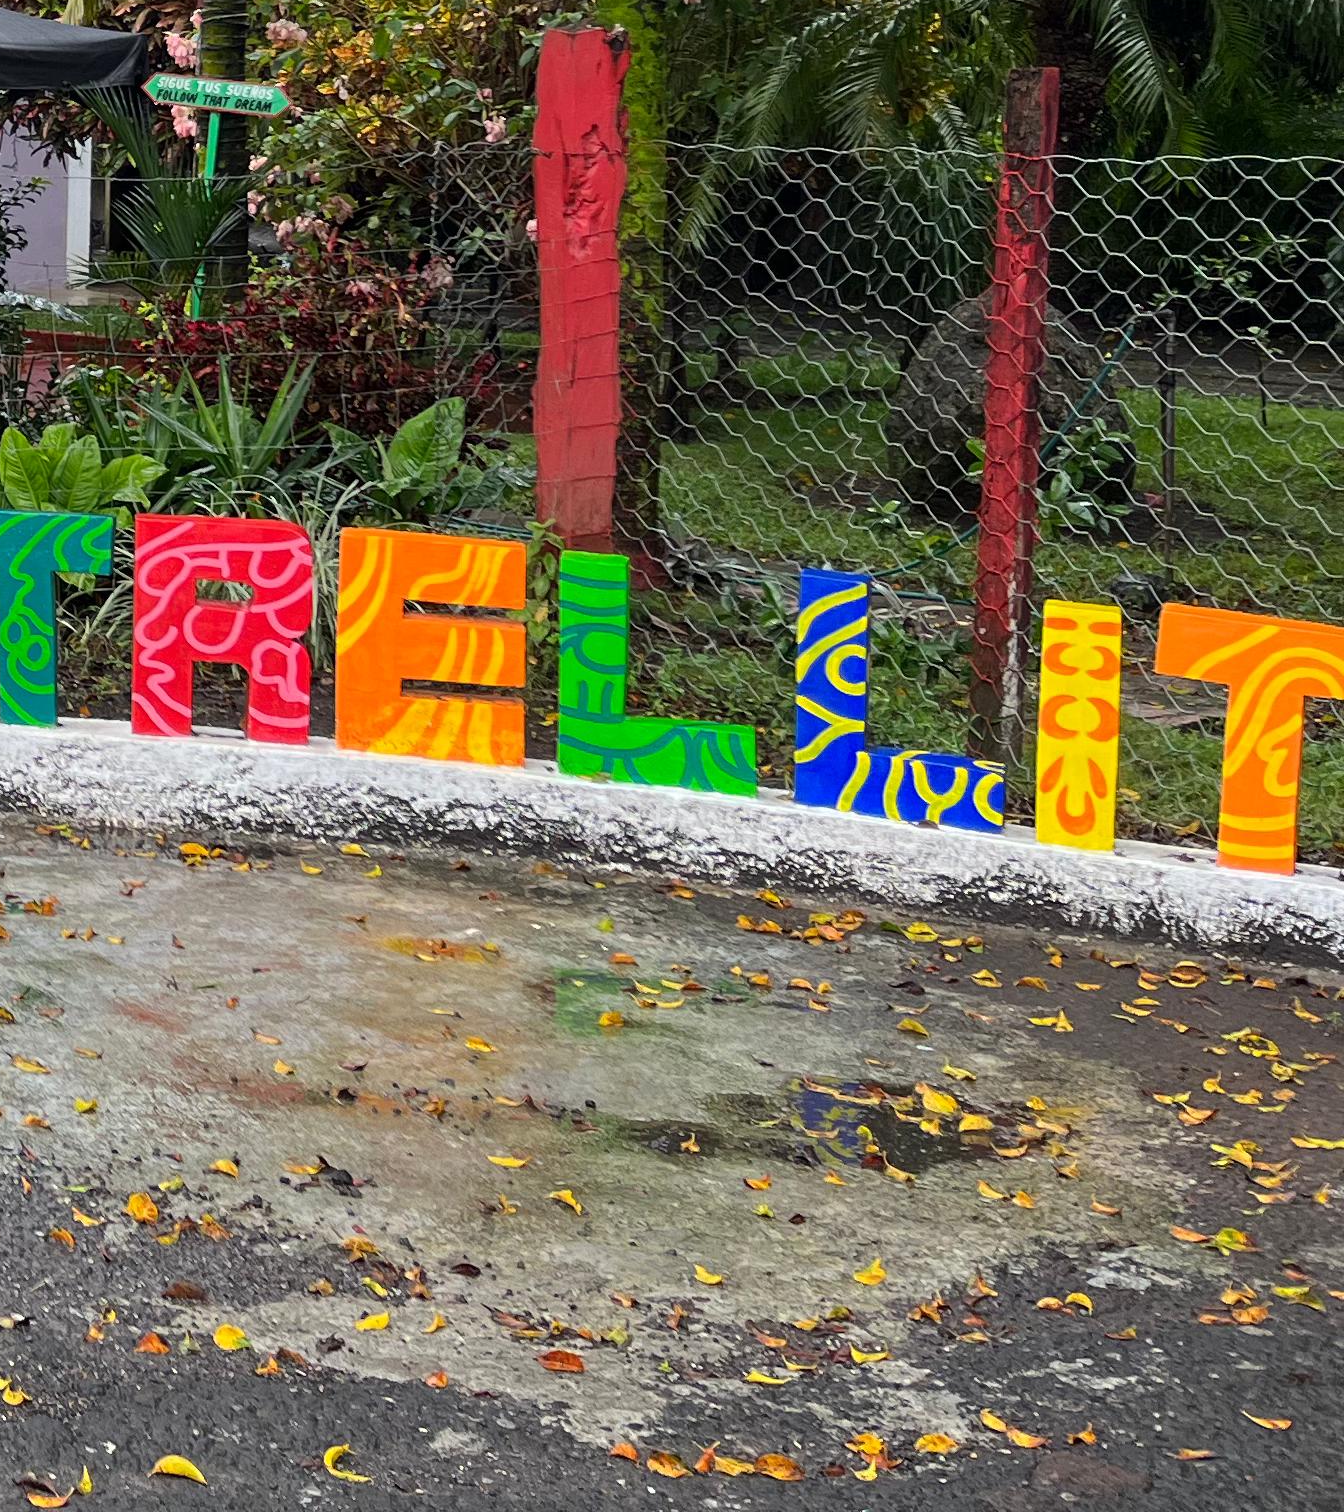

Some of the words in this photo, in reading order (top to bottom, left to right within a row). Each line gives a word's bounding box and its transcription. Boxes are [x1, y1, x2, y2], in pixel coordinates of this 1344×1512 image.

[156, 76, 191, 91] SIGUE
[197, 80, 221, 94] TUS
[156, 89, 199, 104] FOLLOW
[203, 94, 230, 107] THAT
[235, 98, 273, 113] DREAM
